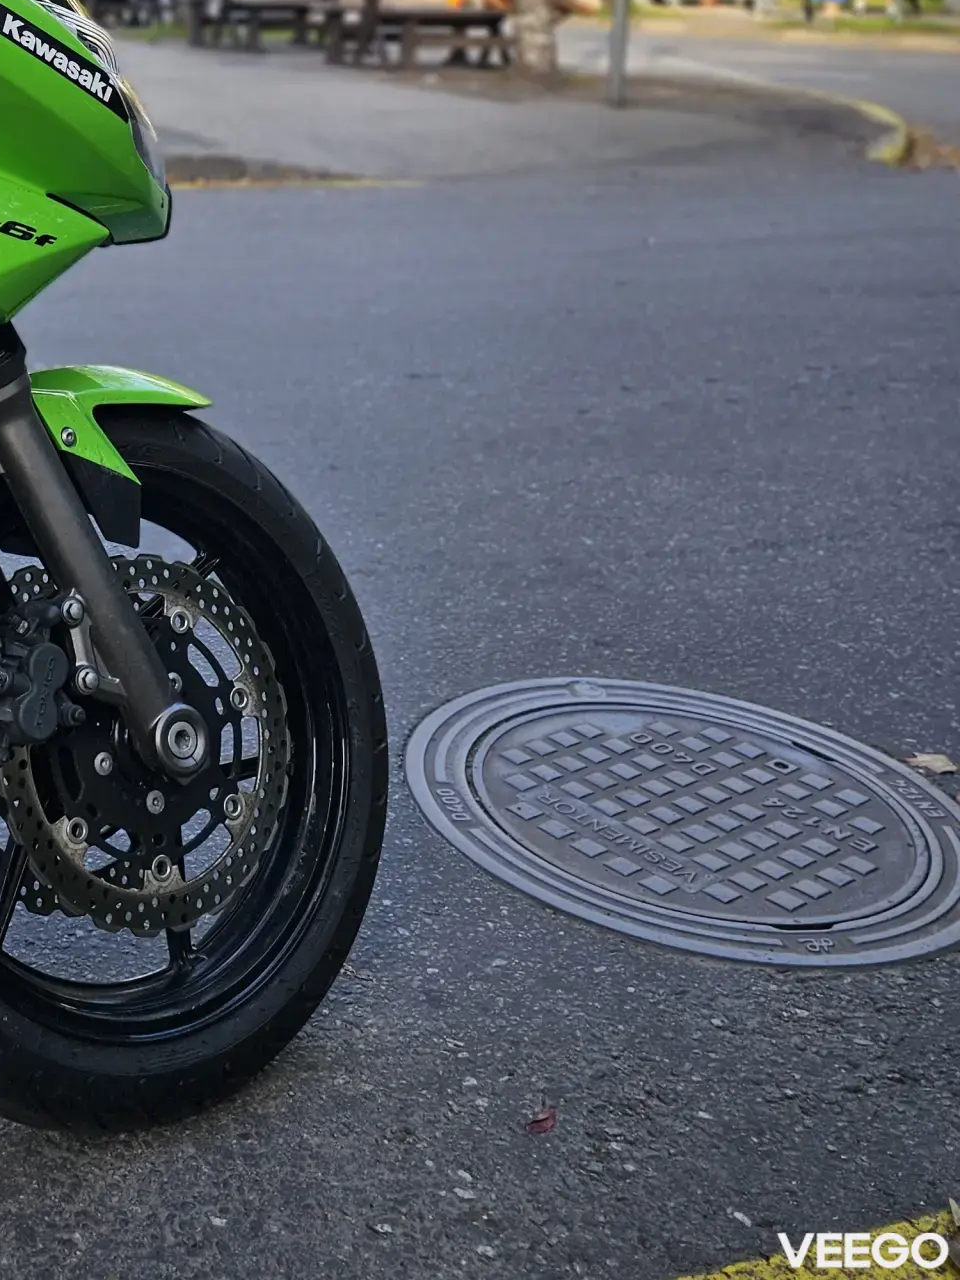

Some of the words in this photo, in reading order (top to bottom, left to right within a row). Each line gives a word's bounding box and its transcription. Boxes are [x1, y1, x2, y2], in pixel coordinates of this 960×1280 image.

[2, 13, 114, 103] Kawasaki
[629, 733, 718, 776] D400
[436, 787, 472, 821] D400
[537, 789, 699, 885] VESIMENTOR
